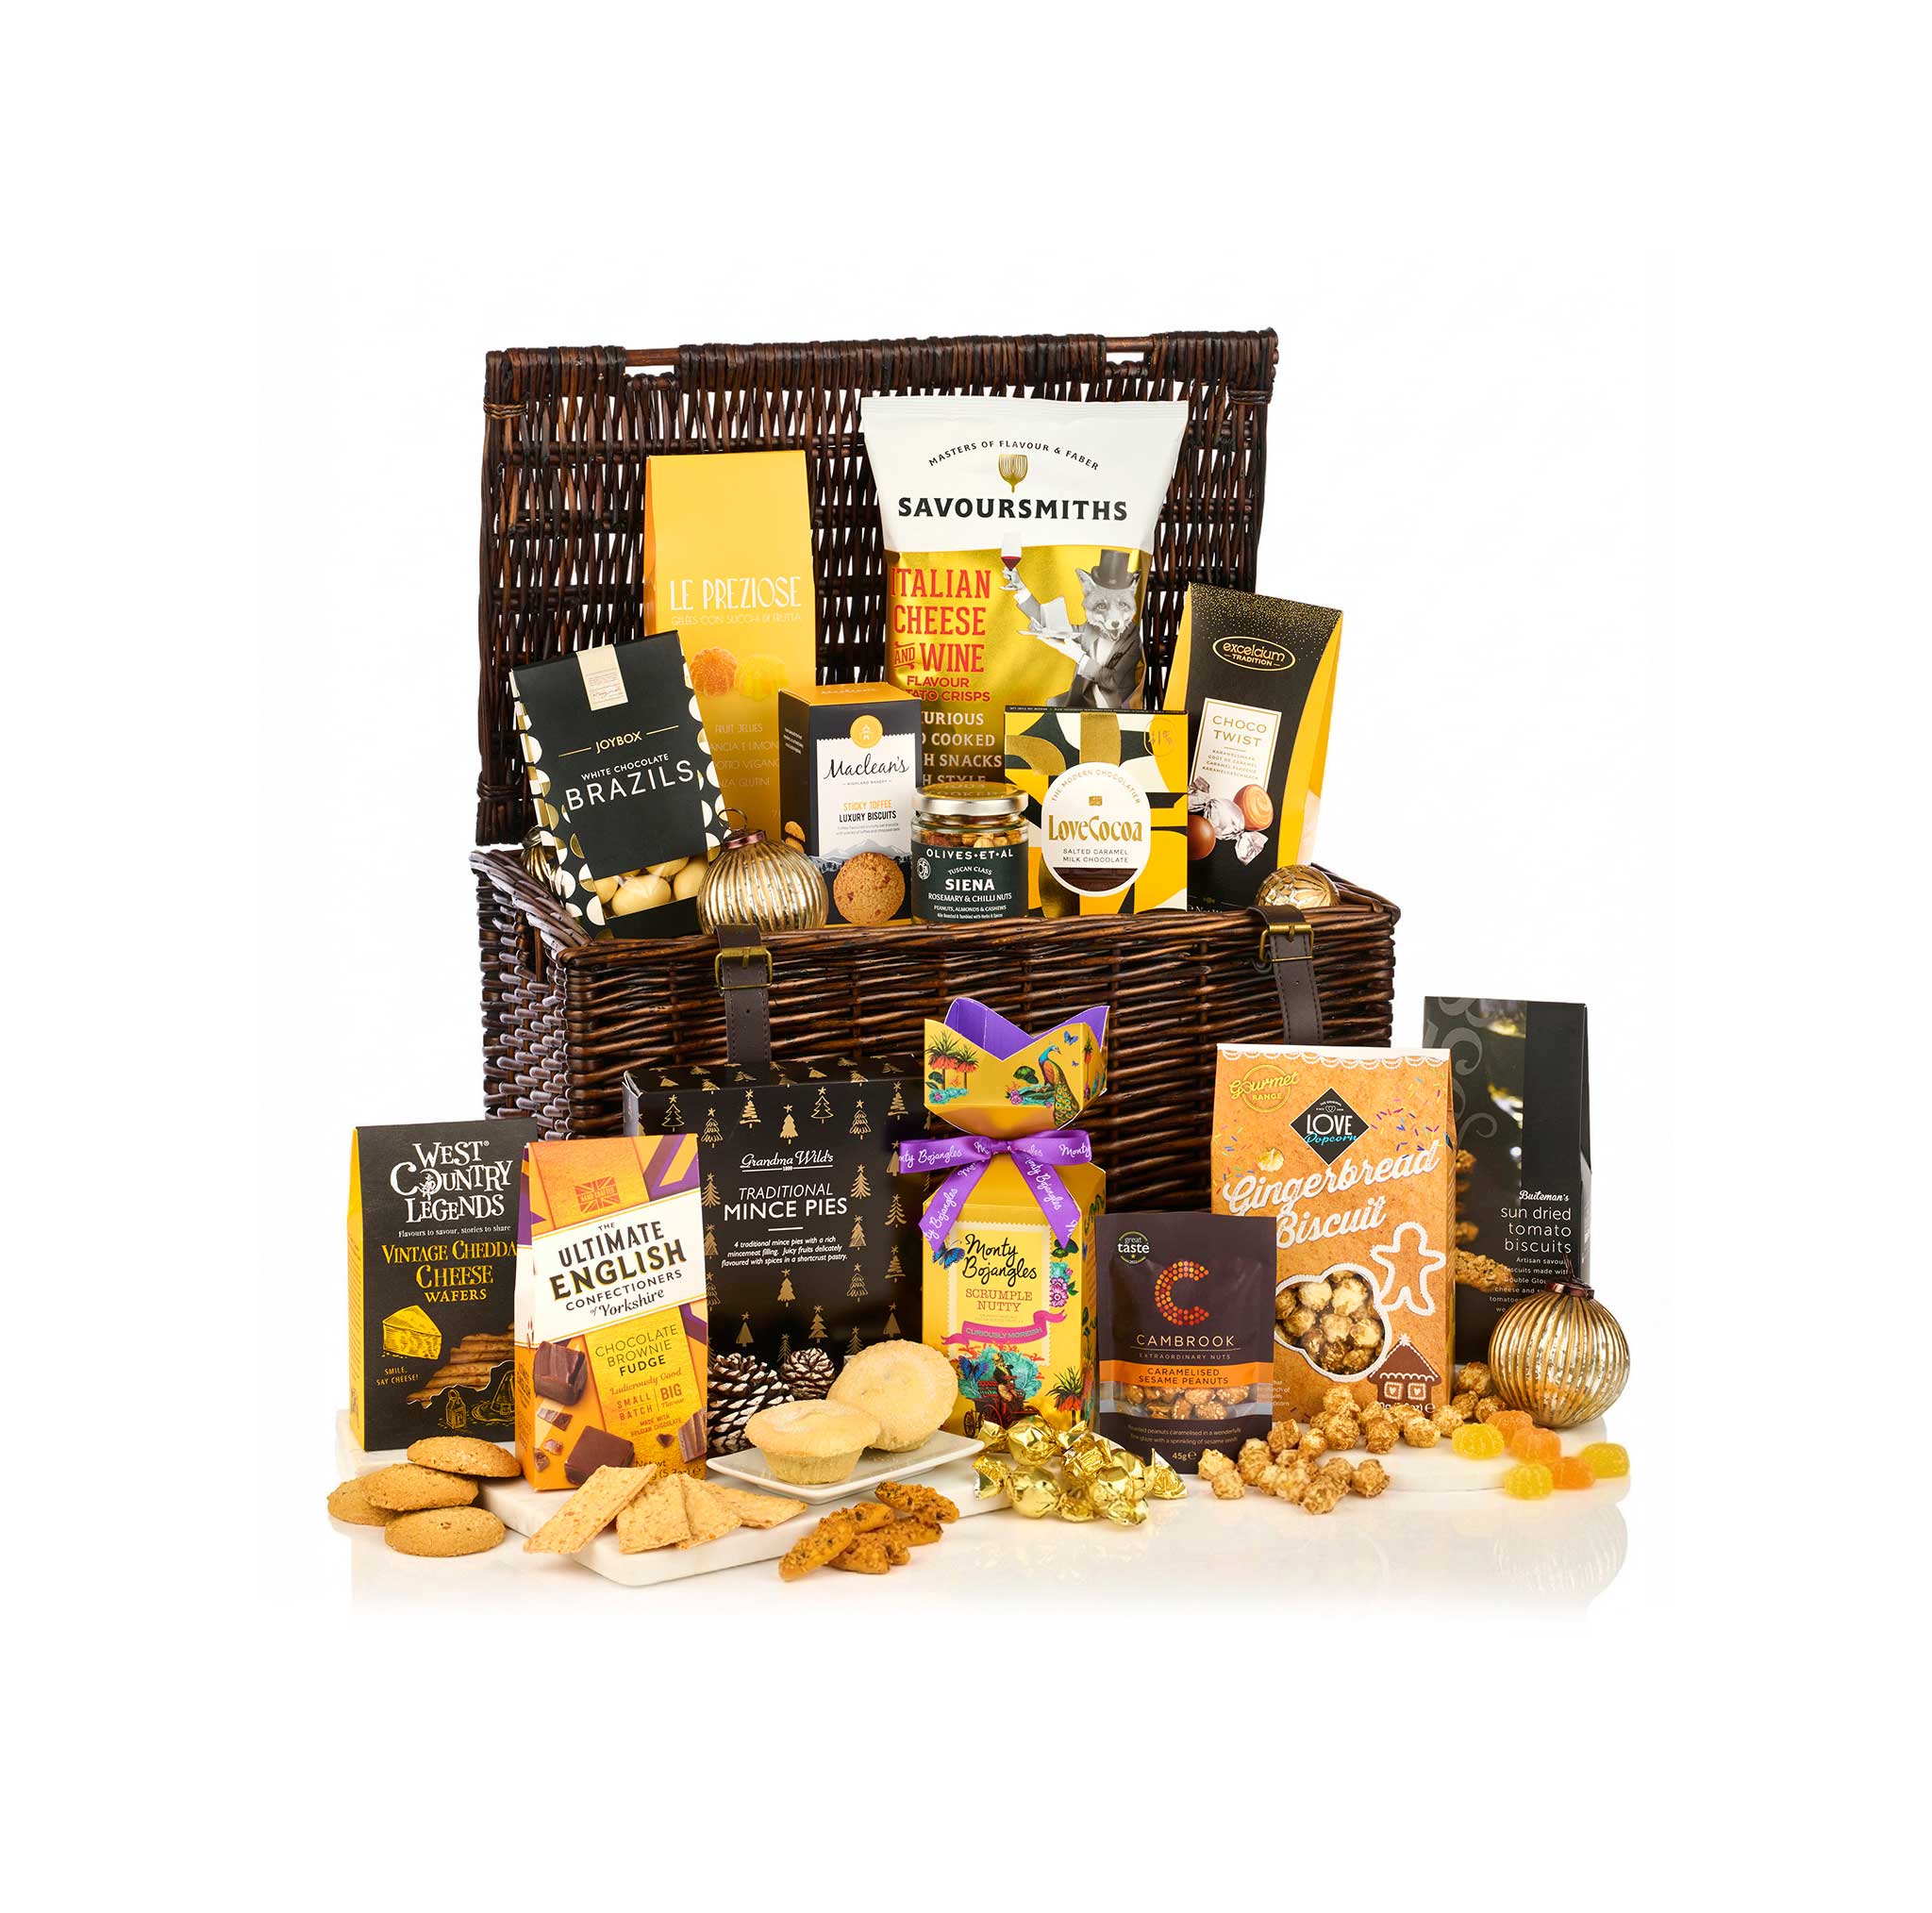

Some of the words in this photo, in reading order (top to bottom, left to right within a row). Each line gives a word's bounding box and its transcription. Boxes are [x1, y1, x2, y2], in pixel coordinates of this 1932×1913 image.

[929, 442, 977, 467] MASTERS
[999, 441, 1049, 452] FLAVOUR
[1054, 446, 1062, 455] &
[1066, 449, 1099, 471] FABER
[898, 497, 1127, 521] SAVOURSMITHS
[891, 568, 991, 599] ITALIAN
[671, 579, 693, 610] LE
[703, 576, 801, 609] PREZIOSE
[893, 605, 986, 636] CHEESE
[894, 646, 915, 666] AND
[920, 643, 985, 673] WINE
[1223, 642, 1286, 662] excelcium
[1231, 653, 1273, 666] TRADITION
[907, 675, 969, 688] FLAVOUR
[906, 689, 939, 701] TATO
[941, 690, 991, 702] CRISPS
[921, 711, 984, 725] URIOUS
[1212, 715, 1267, 734] CHOCO
[595, 731, 642, 754] JOYBOX
[931, 733, 995, 746] COOKED
[1213, 729, 1262, 747] TWIST
[581, 768, 611, 781] WHITE
[614, 754, 670, 774] CHOCOLATE
[824, 753, 910, 780] Maclean's
[940, 754, 1003, 768] SNACKS
[566, 760, 694, 811] BRAZILS
[1061, 770, 1093, 788] MODERN
[843, 801, 867, 811] STICKY
[869, 800, 892, 810] TOFFEE
[839, 812, 865, 823] LUXURY
[867, 810, 896, 821] BISCUITS
[1049, 815, 1142, 841] LoveCocoa
[947, 866, 972, 875] TUSCAN
[945, 878, 995, 891] SIENA
[928, 892, 963, 903] ROSEMARY
[972, 894, 996, 903] CHILLI
[996, 892, 1012, 901] NUTS
[1229, 1072, 1298, 1100] Gourmet
[1253, 1092, 1282, 1102] RANGE
[1307, 1114, 1353, 1136] LOVE
[1304, 1132, 1357, 1146] Popcorn
[740, 1153, 793, 1169] Grandma
[795, 1150, 834, 1165] Wild's
[918, 1145, 962, 1165] Bojangles
[1223, 1139, 1441, 1217] Gingerbread
[739, 1183, 833, 1201] TRADITIONAL
[1519, 1189, 1570, 1202] Buiteman's
[405, 1194, 506, 1223] LEGENDS
[724, 1201, 797, 1221] MINCE
[806, 1198, 847, 1216] PIES
[1501, 1207, 1527, 1219] sun
[1533, 1206, 1571, 1221] dried
[598, 1222, 615, 1231] THE
[1276, 1195, 1388, 1249] Biscuit
[1508, 1223, 1572, 1238] tomato
[398, 1229, 425, 1238] Flavours
[460, 1225, 483, 1234] stories
[381, 1244, 448, 1265] VINTAGE
[452, 1240, 517, 1260] CHEDDA
[558, 1221, 664, 1268] ULTIMATE
[741, 1239, 771, 1248] traditional
[791, 1239, 803, 1247] pies
[782, 1247, 797, 1256] Juicy
[798, 1246, 813, 1255] fruits
[814, 1244, 842, 1254] delicately
[965, 1234, 1018, 1267] Monty
[1118, 1242, 1150, 1254] taste
[1505, 1238, 1572, 1254] biscuits
[549, 1239, 687, 1301] ENGLISH
[722, 1259, 749, 1268] flavoured
[765, 1257, 782, 1266] spices
[963, 1256, 1037, 1287] Bojangles
[416, 1265, 493, 1289] CHEESE
[425, 1289, 487, 1306] WAFERS
[566, 1270, 682, 1311] CONFECTIONERS
[966, 1289, 1033, 1302] SCRUMPLE
[598, 1289, 664, 1317] Yorkshire
[977, 1301, 1021, 1312] NUTTY
[595, 1324, 678, 1357] CHOCOLATE
[1137, 1335, 1234, 1347] CAMBROOK
[607, 1339, 672, 1367] BROWNIE
[620, 1355, 666, 1376] FUDGE
[1147, 1368, 1220, 1376] CARAMELISED
[391, 1373, 419, 1384] CHEESE!
[609, 1375, 658, 1395] Ludicrously
[660, 1367, 682, 1380] Good
[1139, 1375, 1178, 1385] SESAME
[617, 1392, 652, 1409] SMALL
[660, 1384, 682, 1401] BIG
[619, 1406, 654, 1421] BATCH
[1173, 1453, 1188, 1461] 45g
